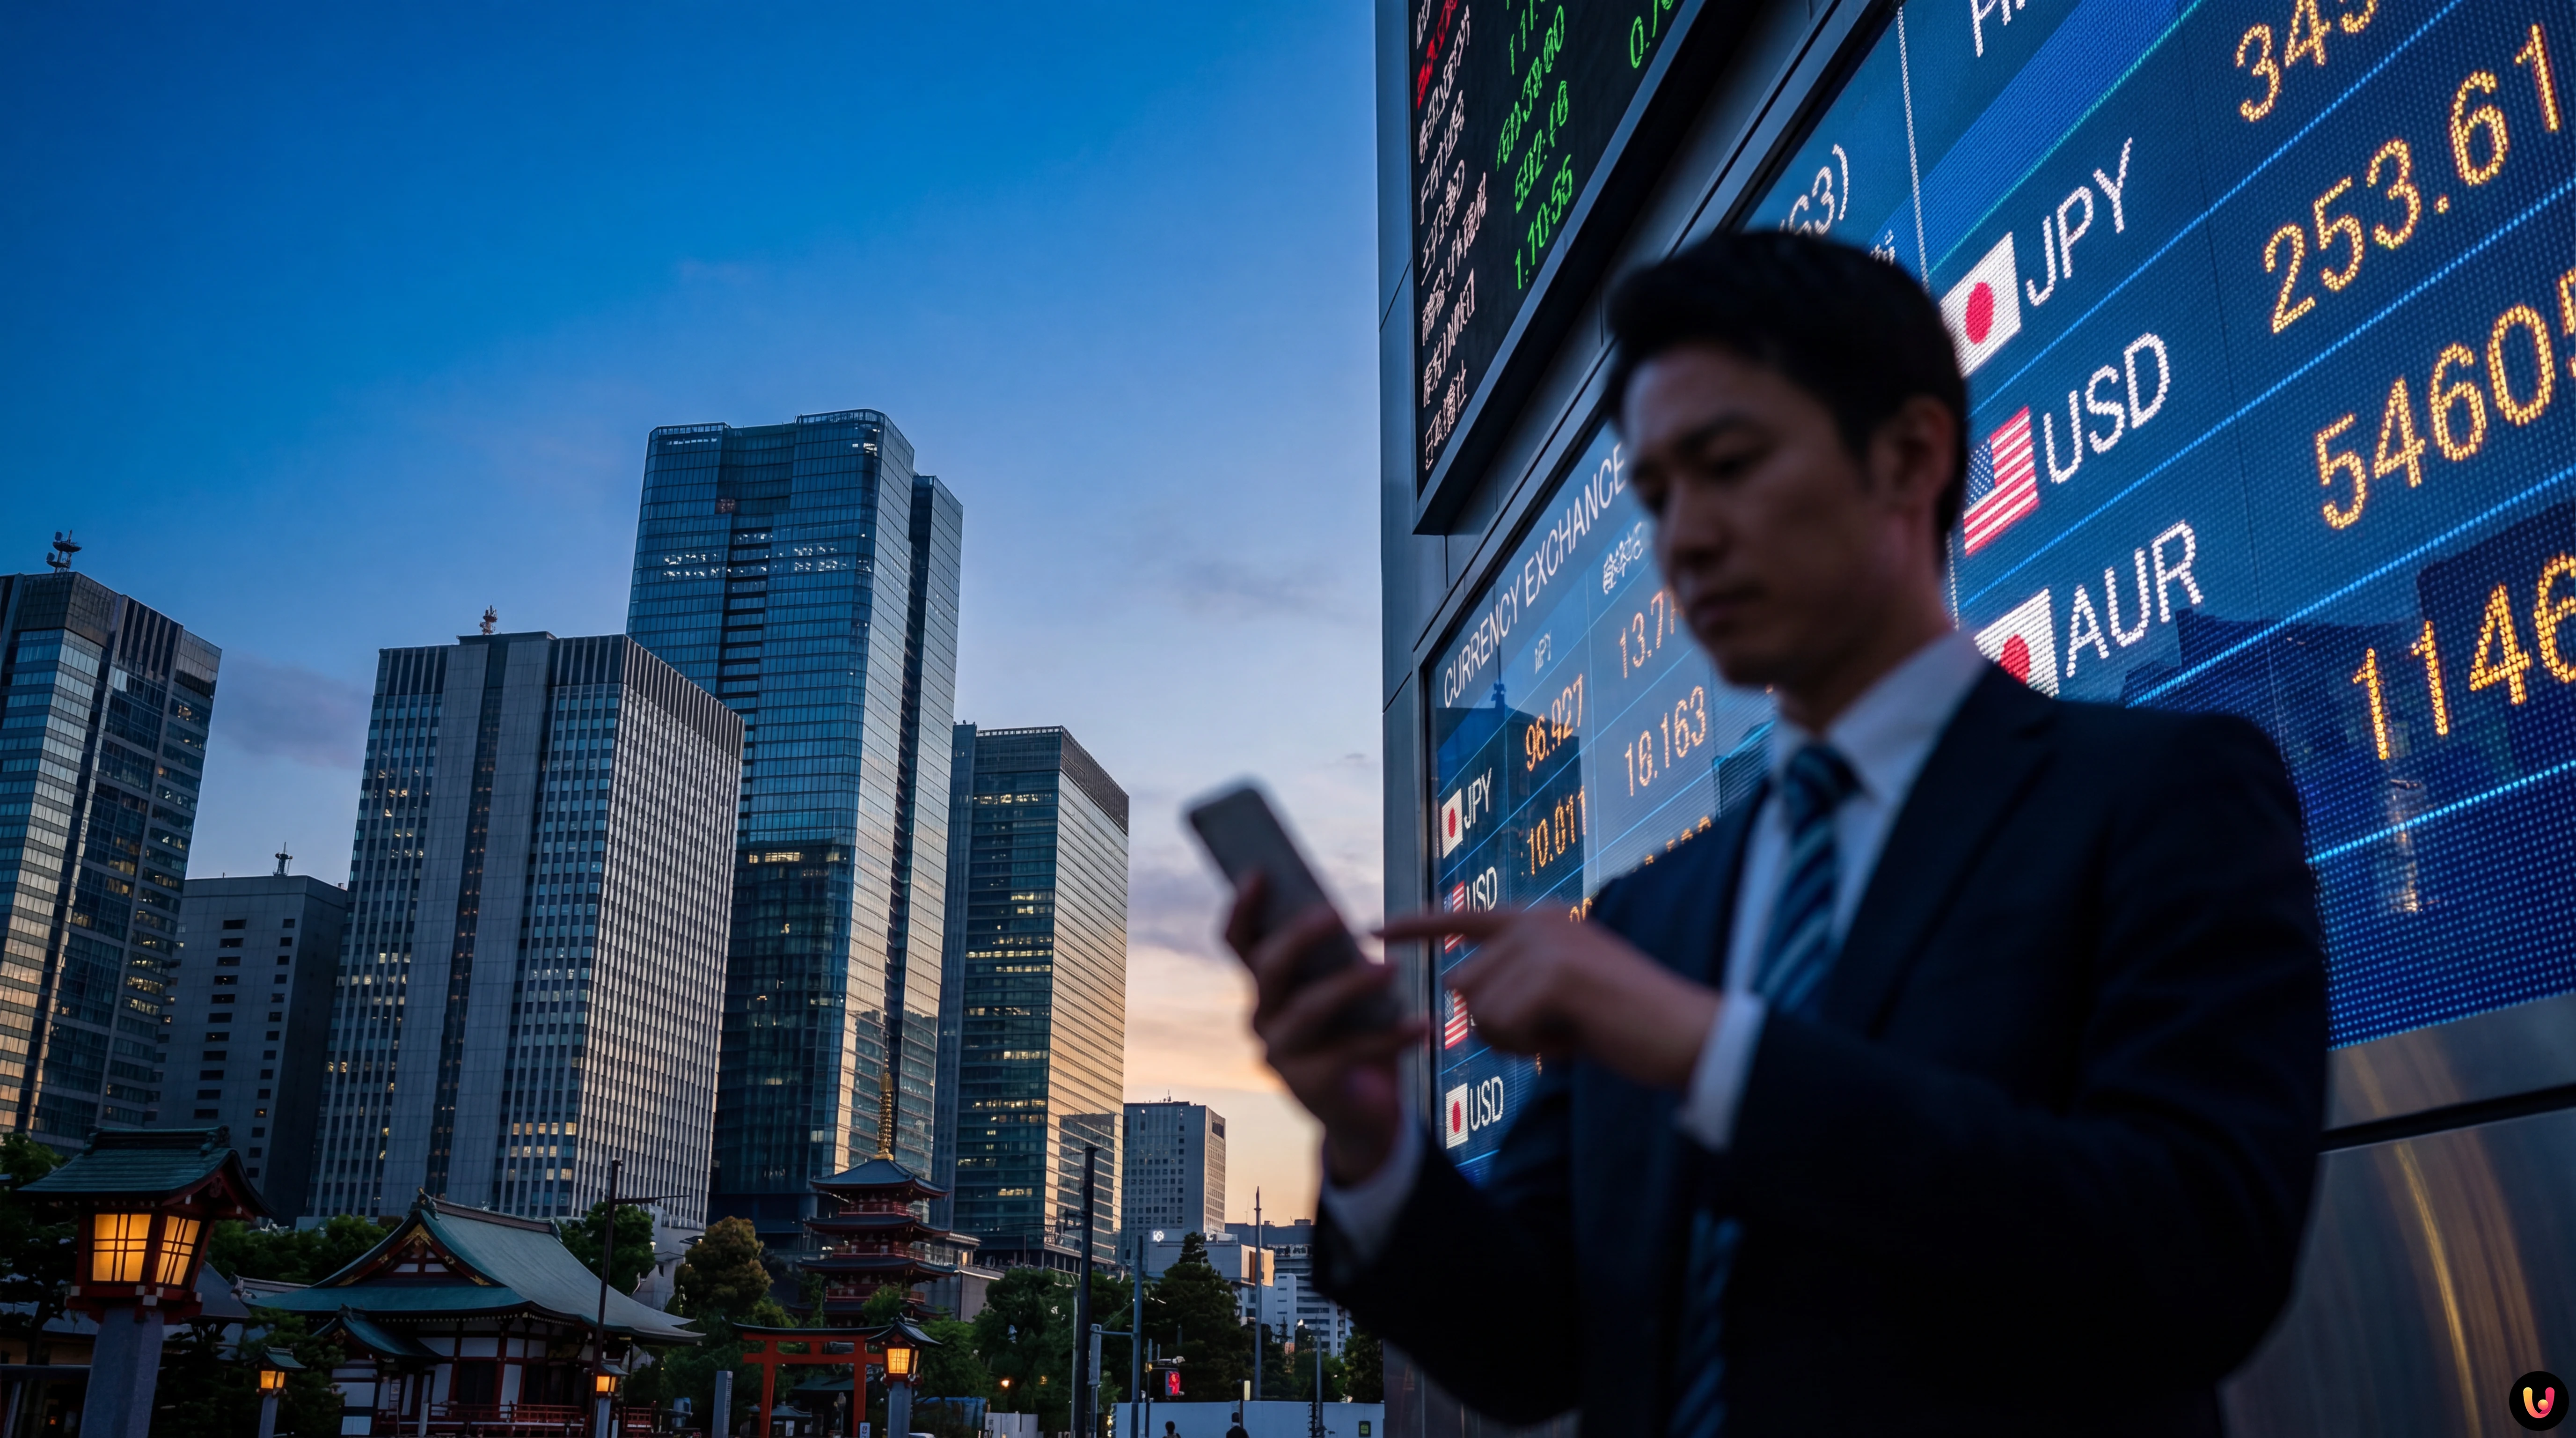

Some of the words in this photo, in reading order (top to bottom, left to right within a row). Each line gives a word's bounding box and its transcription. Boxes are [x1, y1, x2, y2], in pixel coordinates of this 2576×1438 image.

[2026, 137, 2132, 306] JPY
[2264, 23, 2561, 333] 253.61
[2043, 332, 2170, 484] USD
[1444, 575, 1521, 708] CURRENCY
[2066, 520, 2203, 677] AUR
[1464, 767, 1492, 829] JPY
[1470, 1076, 1504, 1131] USD
